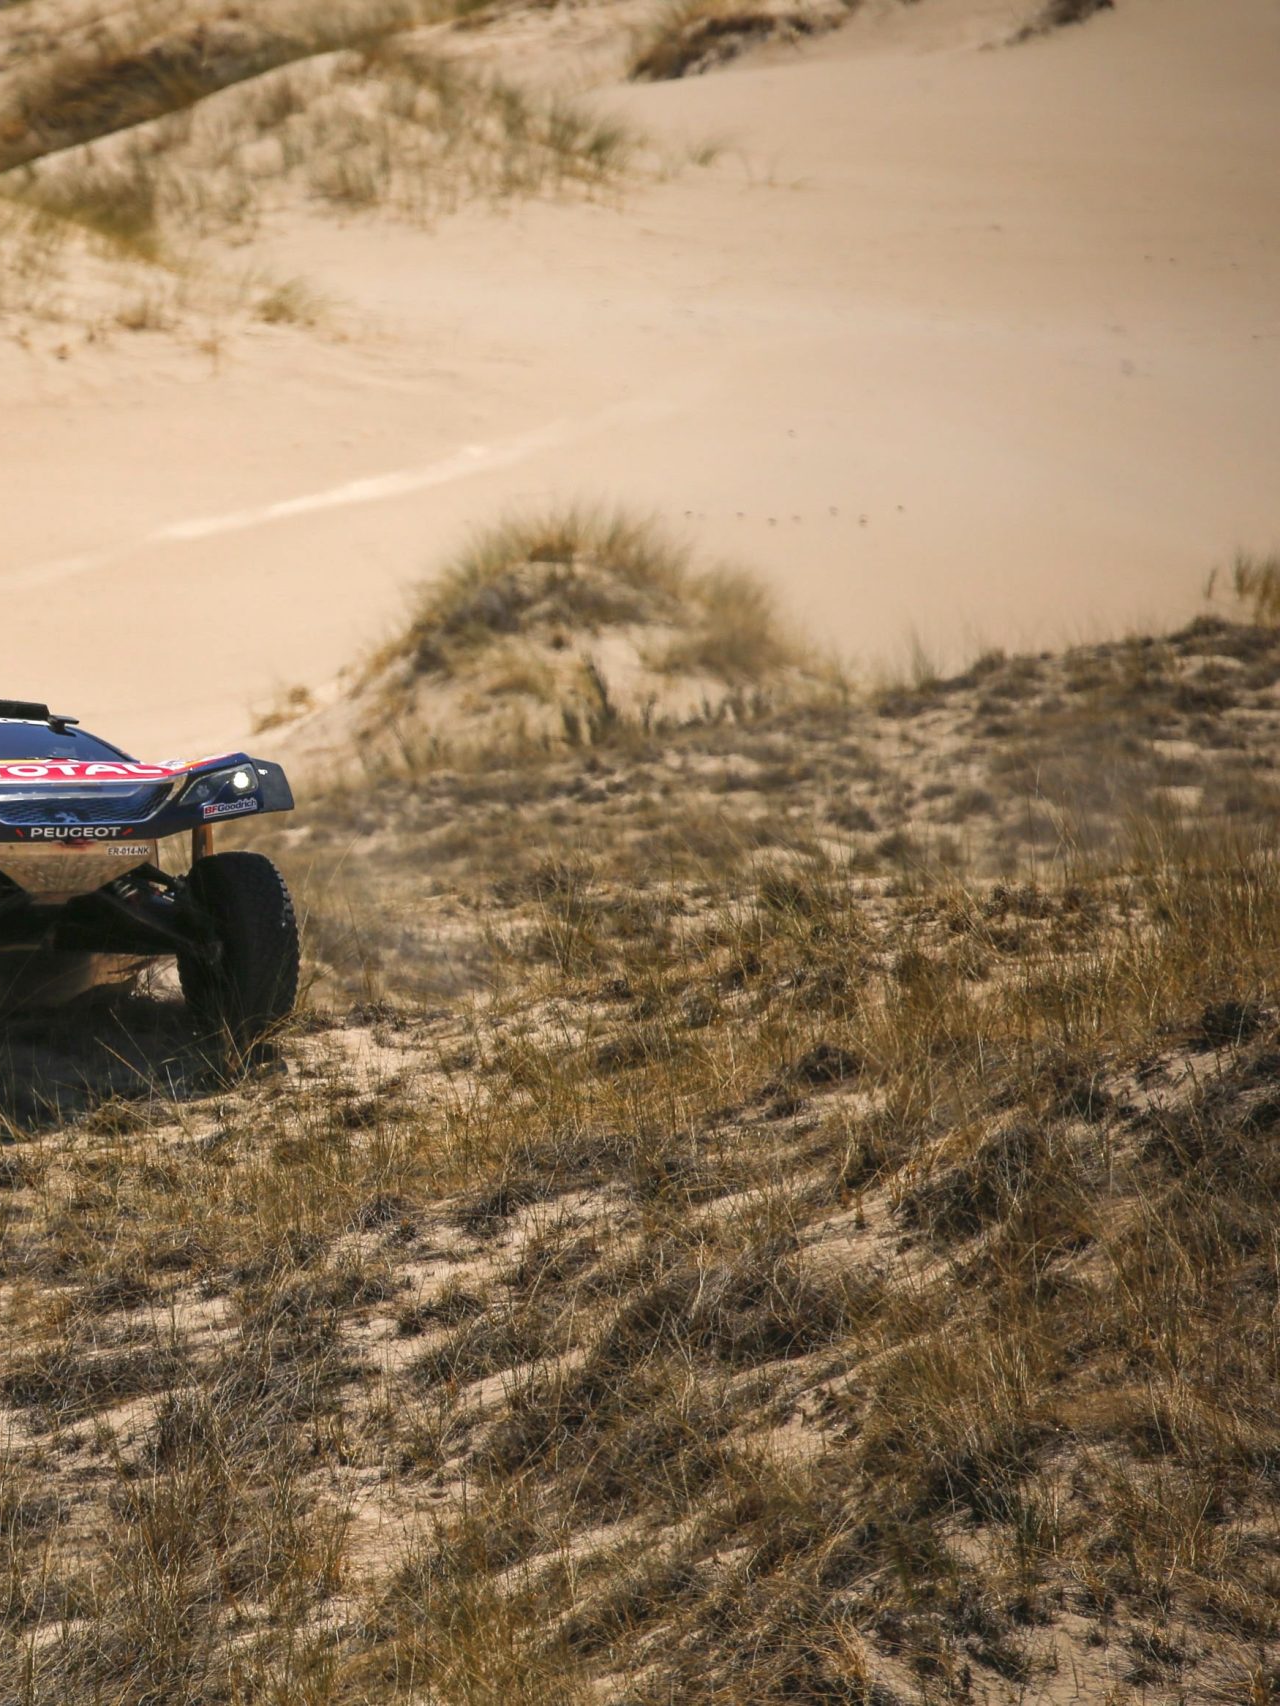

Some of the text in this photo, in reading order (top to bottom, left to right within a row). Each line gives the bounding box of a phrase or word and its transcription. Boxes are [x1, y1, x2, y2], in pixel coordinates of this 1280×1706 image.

[204, 799, 257, 815] BFGoodrich
[30, 826, 121, 838] PEUGEOT
[107, 846, 150, 856] ER-014-NK
